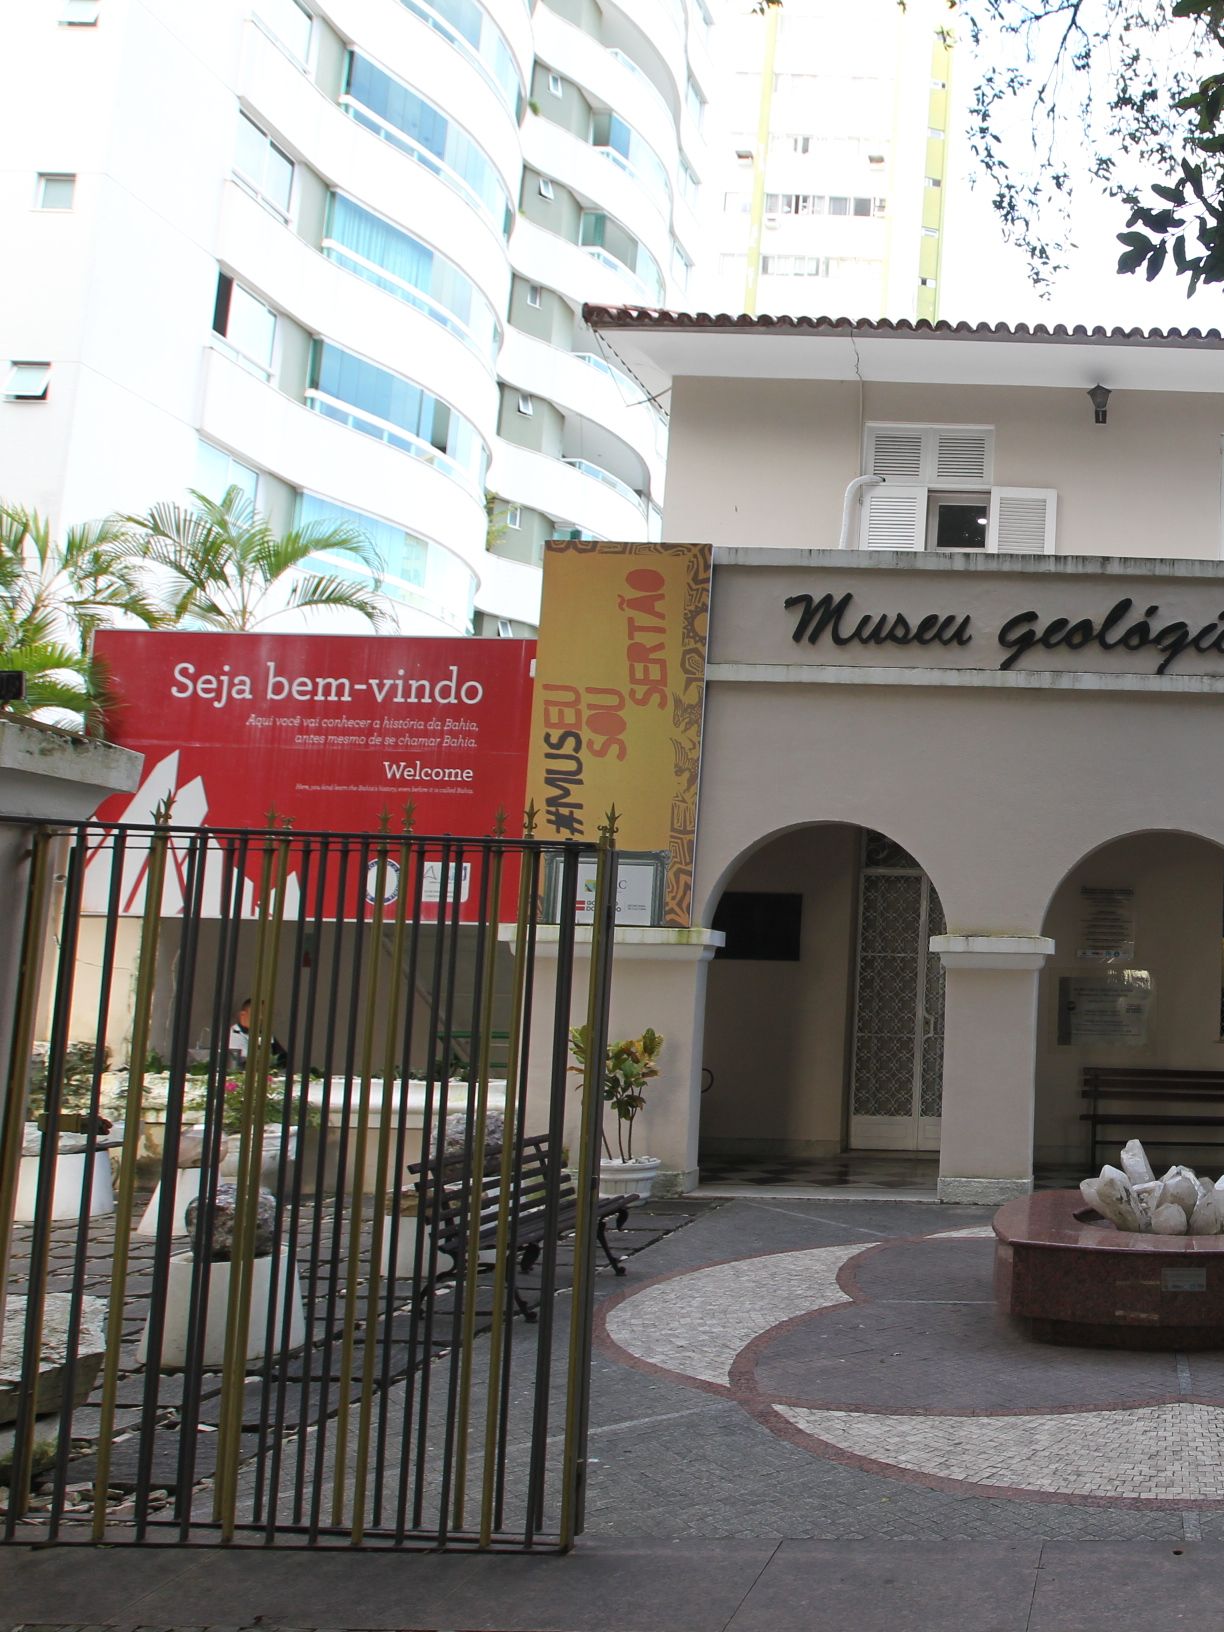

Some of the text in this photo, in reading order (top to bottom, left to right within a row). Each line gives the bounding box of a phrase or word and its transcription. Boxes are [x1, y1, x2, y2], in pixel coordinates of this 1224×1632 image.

[617, 567, 668, 711] SERTÃO
[784, 592, 972, 648] Museu
[170, 661, 484, 708] Seja bem-vindo
[246, 713, 479, 732] Aqui você vai conhecer a história da Bahia,
[295, 733, 478, 748] antes mesmo de se chamar Bahia.
[584, 686, 627, 762] SOU
[383, 760, 474, 782] Welcome
[542, 683, 585, 837] #MUSEU
